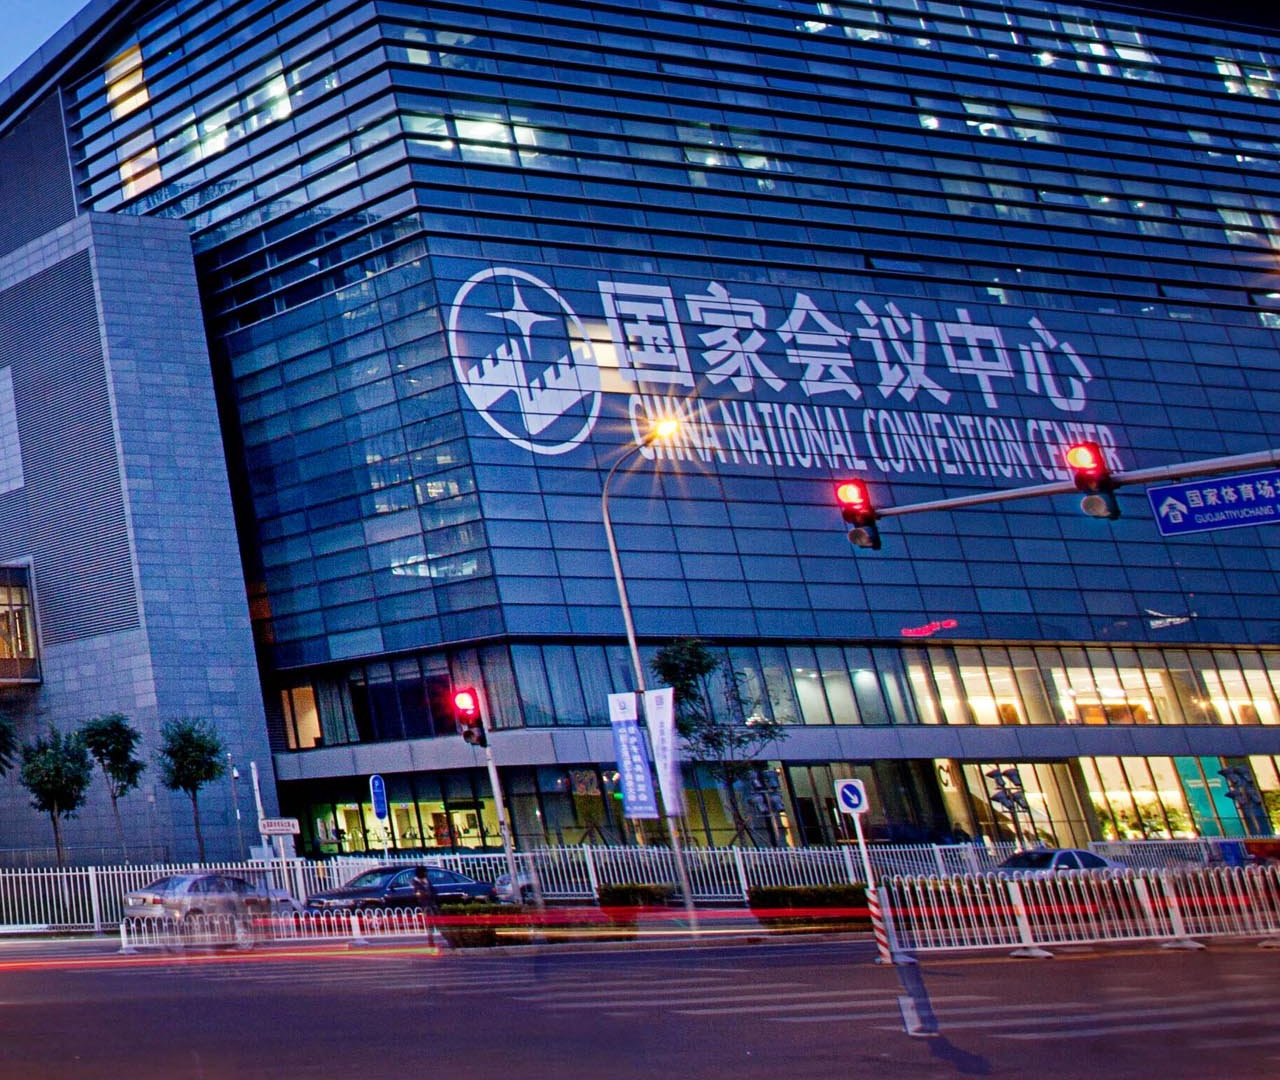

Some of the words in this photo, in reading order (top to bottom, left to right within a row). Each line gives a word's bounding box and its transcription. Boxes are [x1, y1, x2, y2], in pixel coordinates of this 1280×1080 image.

[597, 279, 1095, 412] 国家会议中心
[628, 393, 727, 464] CHINA
[719, 399, 868, 471] NATIONAL
[863, 407, 1035, 480] CONVENTION
